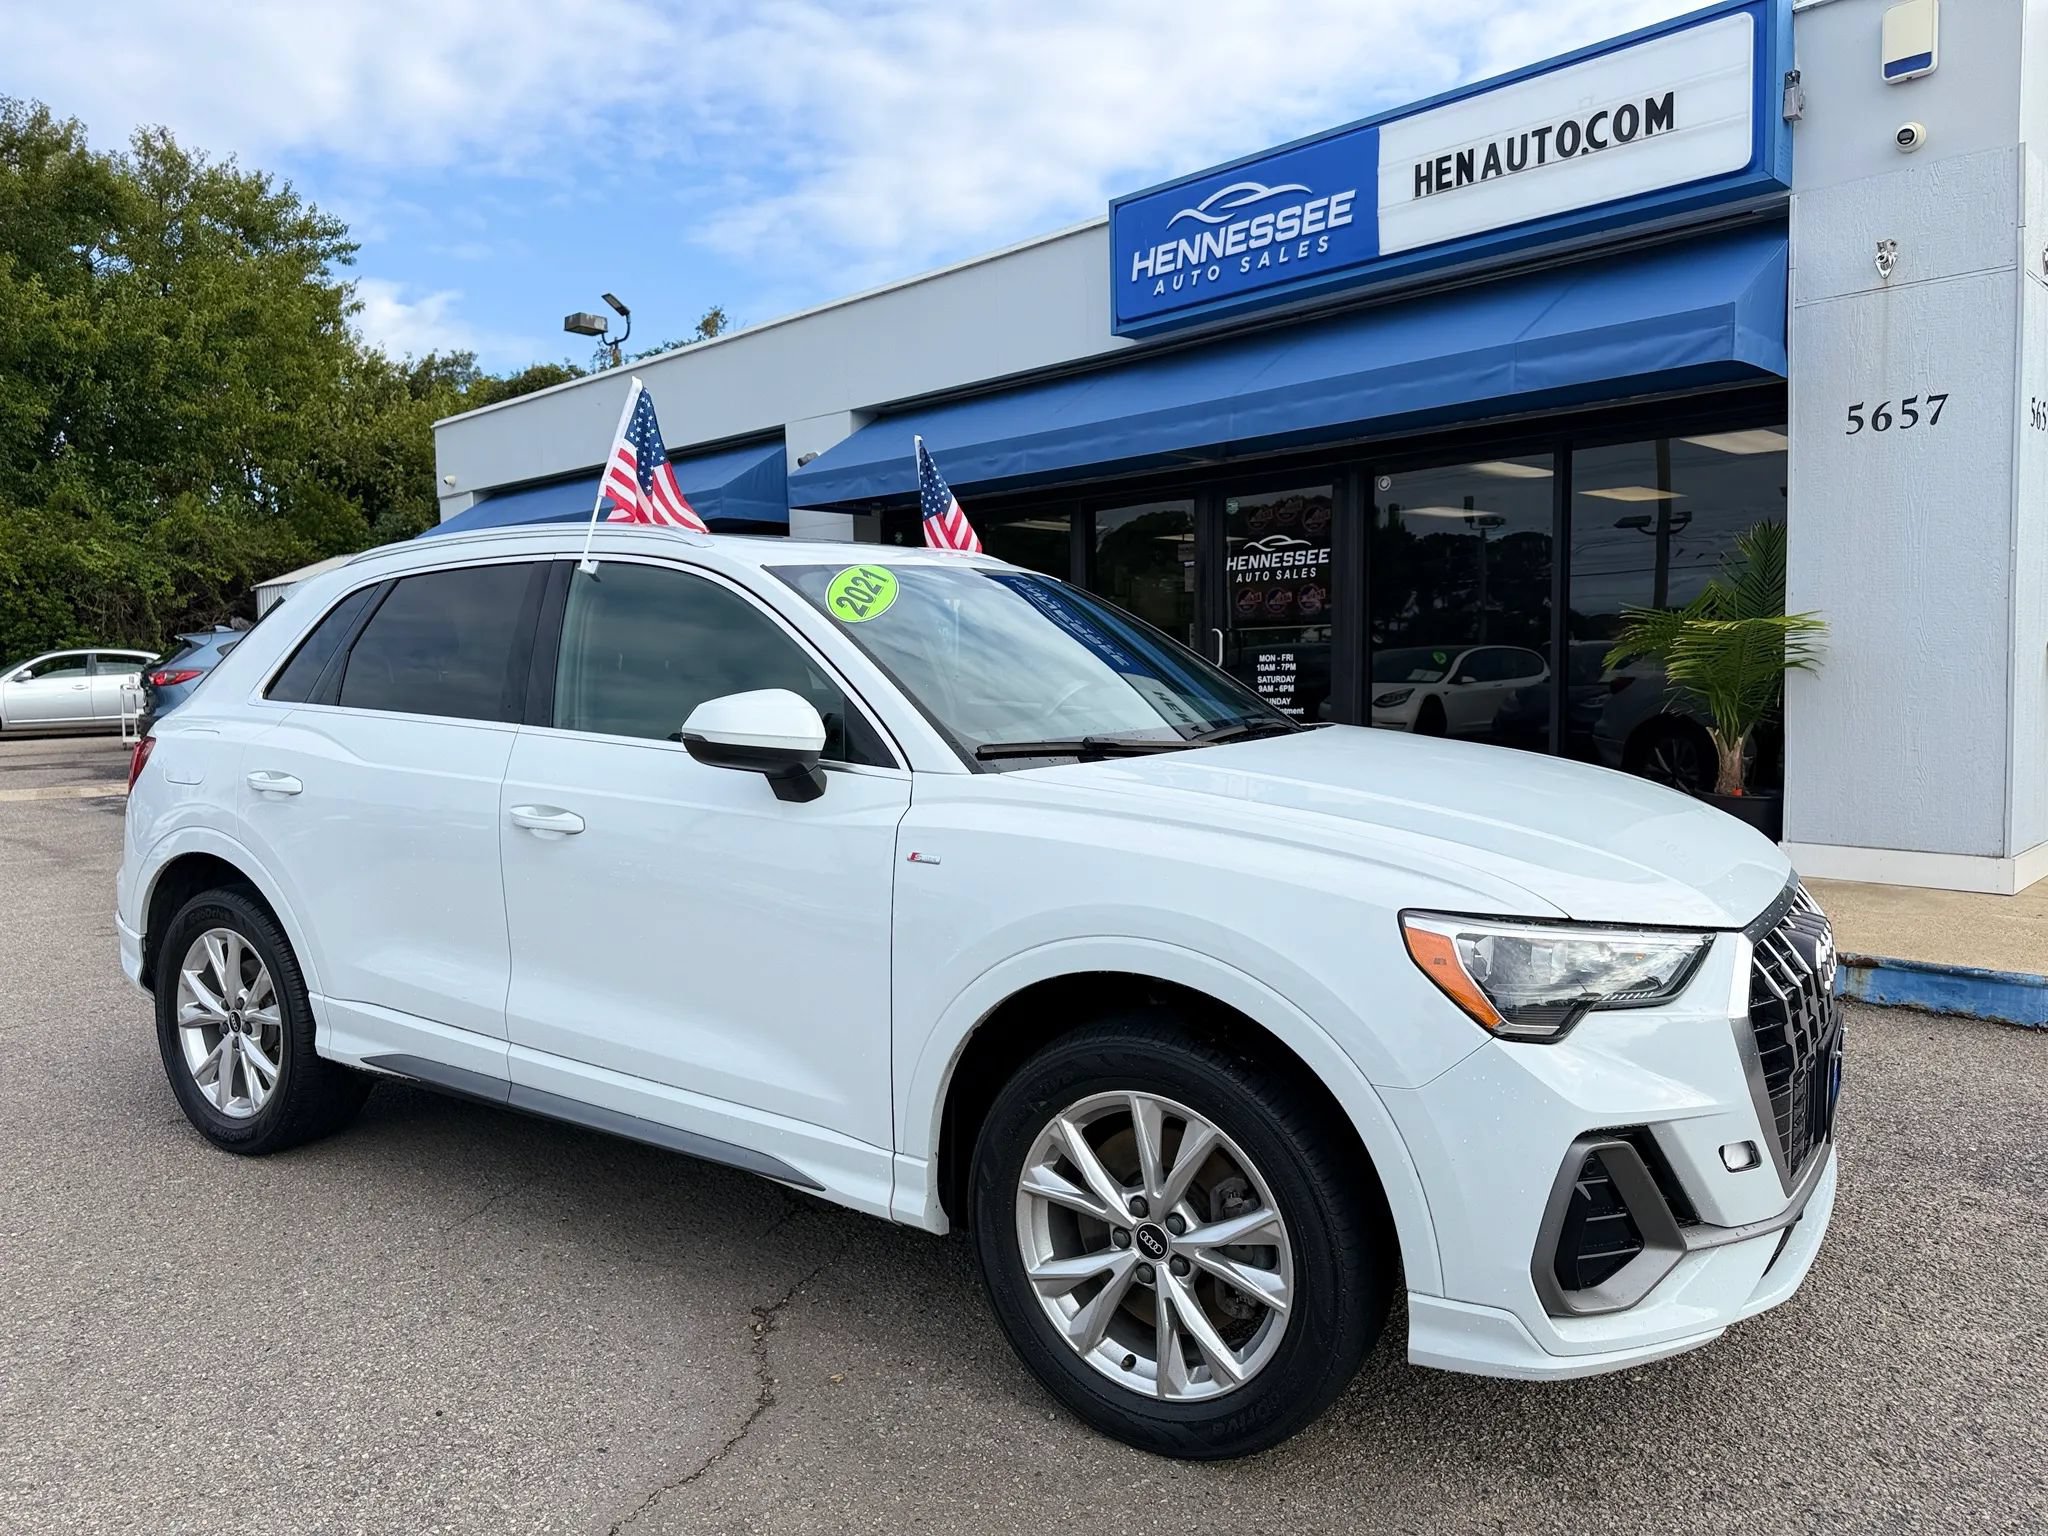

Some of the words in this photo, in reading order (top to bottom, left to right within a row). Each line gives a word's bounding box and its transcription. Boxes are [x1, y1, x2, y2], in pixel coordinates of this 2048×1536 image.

[1413, 91, 1676, 198] HENAUTO.COM
[1131, 189, 1357, 283] HENNESSEE
[1153, 264, 1221, 297] AUTO
[1239, 235, 1329, 273] SALES
[1846, 393, 1949, 435] 5657
[2030, 396, 2048, 432] 565
[1226, 548, 1331, 571] HENNESSEE
[1236, 570, 1270, 584] AUTO
[1275, 567, 1317, 581] SALES
[835, 567, 890, 618] 2021
[1256, 663, 1276, 671] 10AM
[1281, 662, 1297, 671] 7PM
[1259, 654, 1276, 662] MON
[1281, 653, 1294, 661] FRI
[1257, 675, 1296, 683] SATURDAY
[1264, 697, 1292, 705] UNDAY
